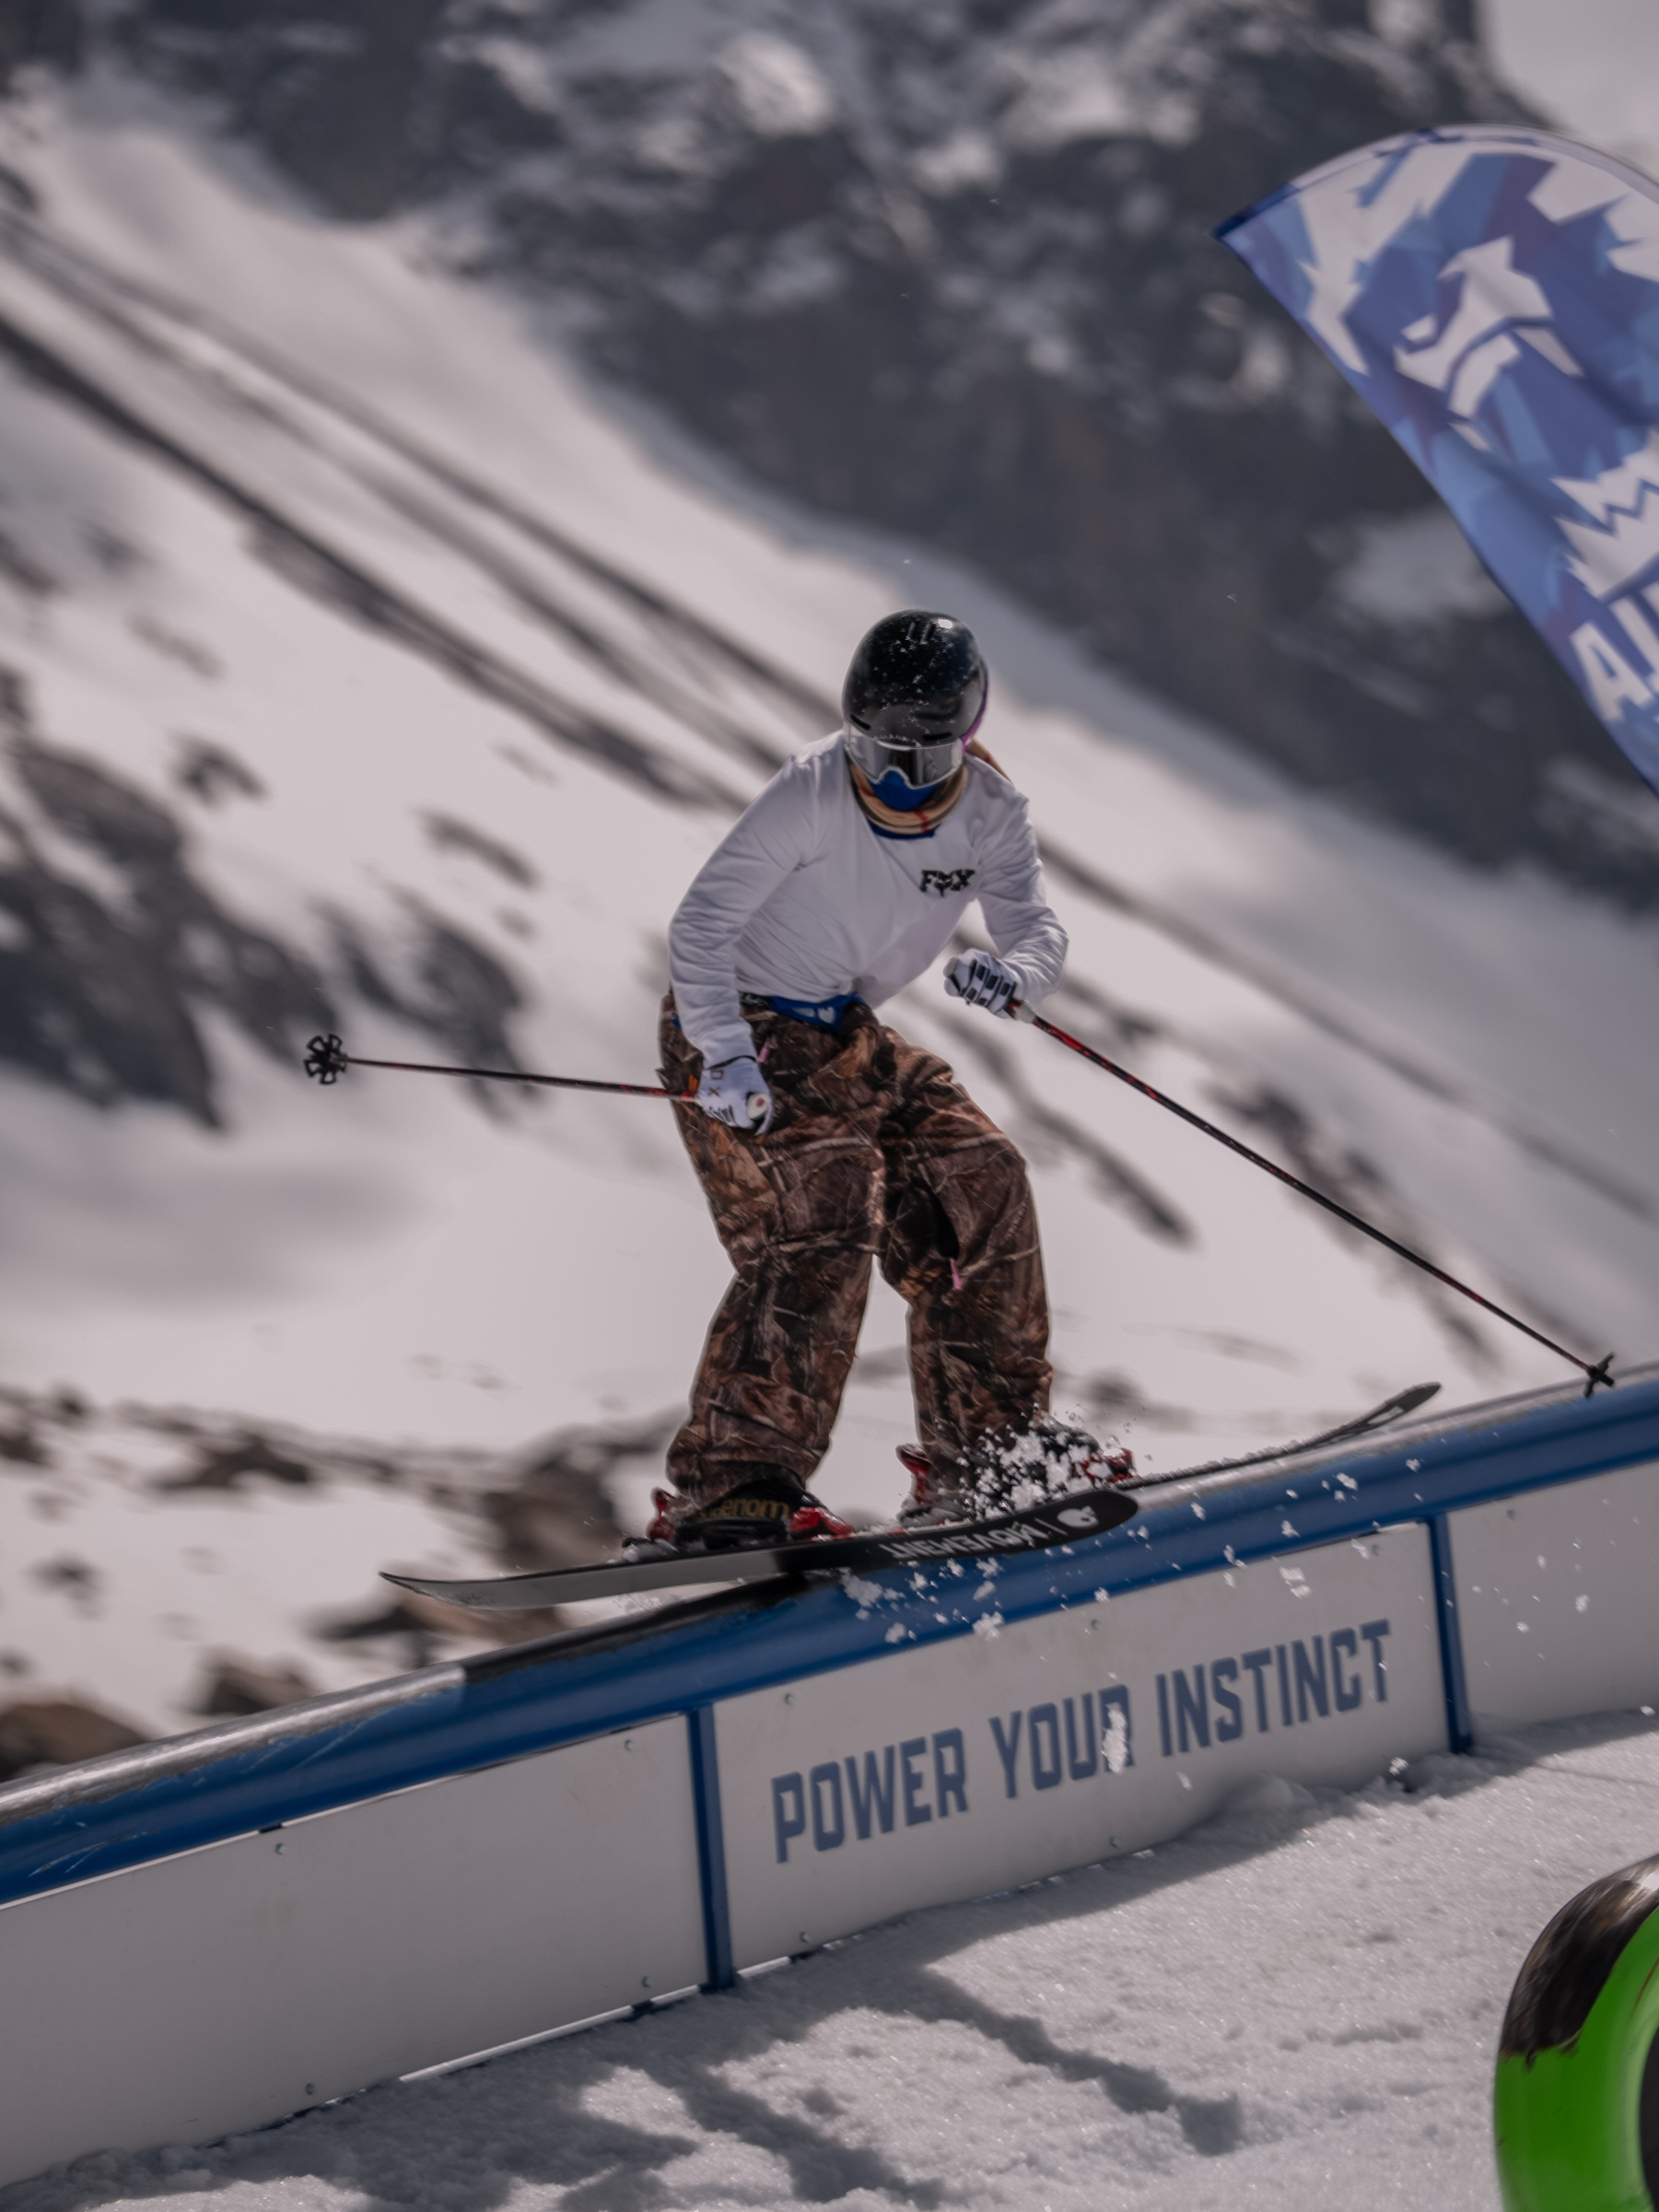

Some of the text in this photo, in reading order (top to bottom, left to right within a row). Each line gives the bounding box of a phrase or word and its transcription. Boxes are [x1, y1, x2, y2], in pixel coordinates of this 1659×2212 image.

[920, 869, 975, 897] FOX
[771, 1619, 1391, 1864] POWER YOUR INSTINCT
